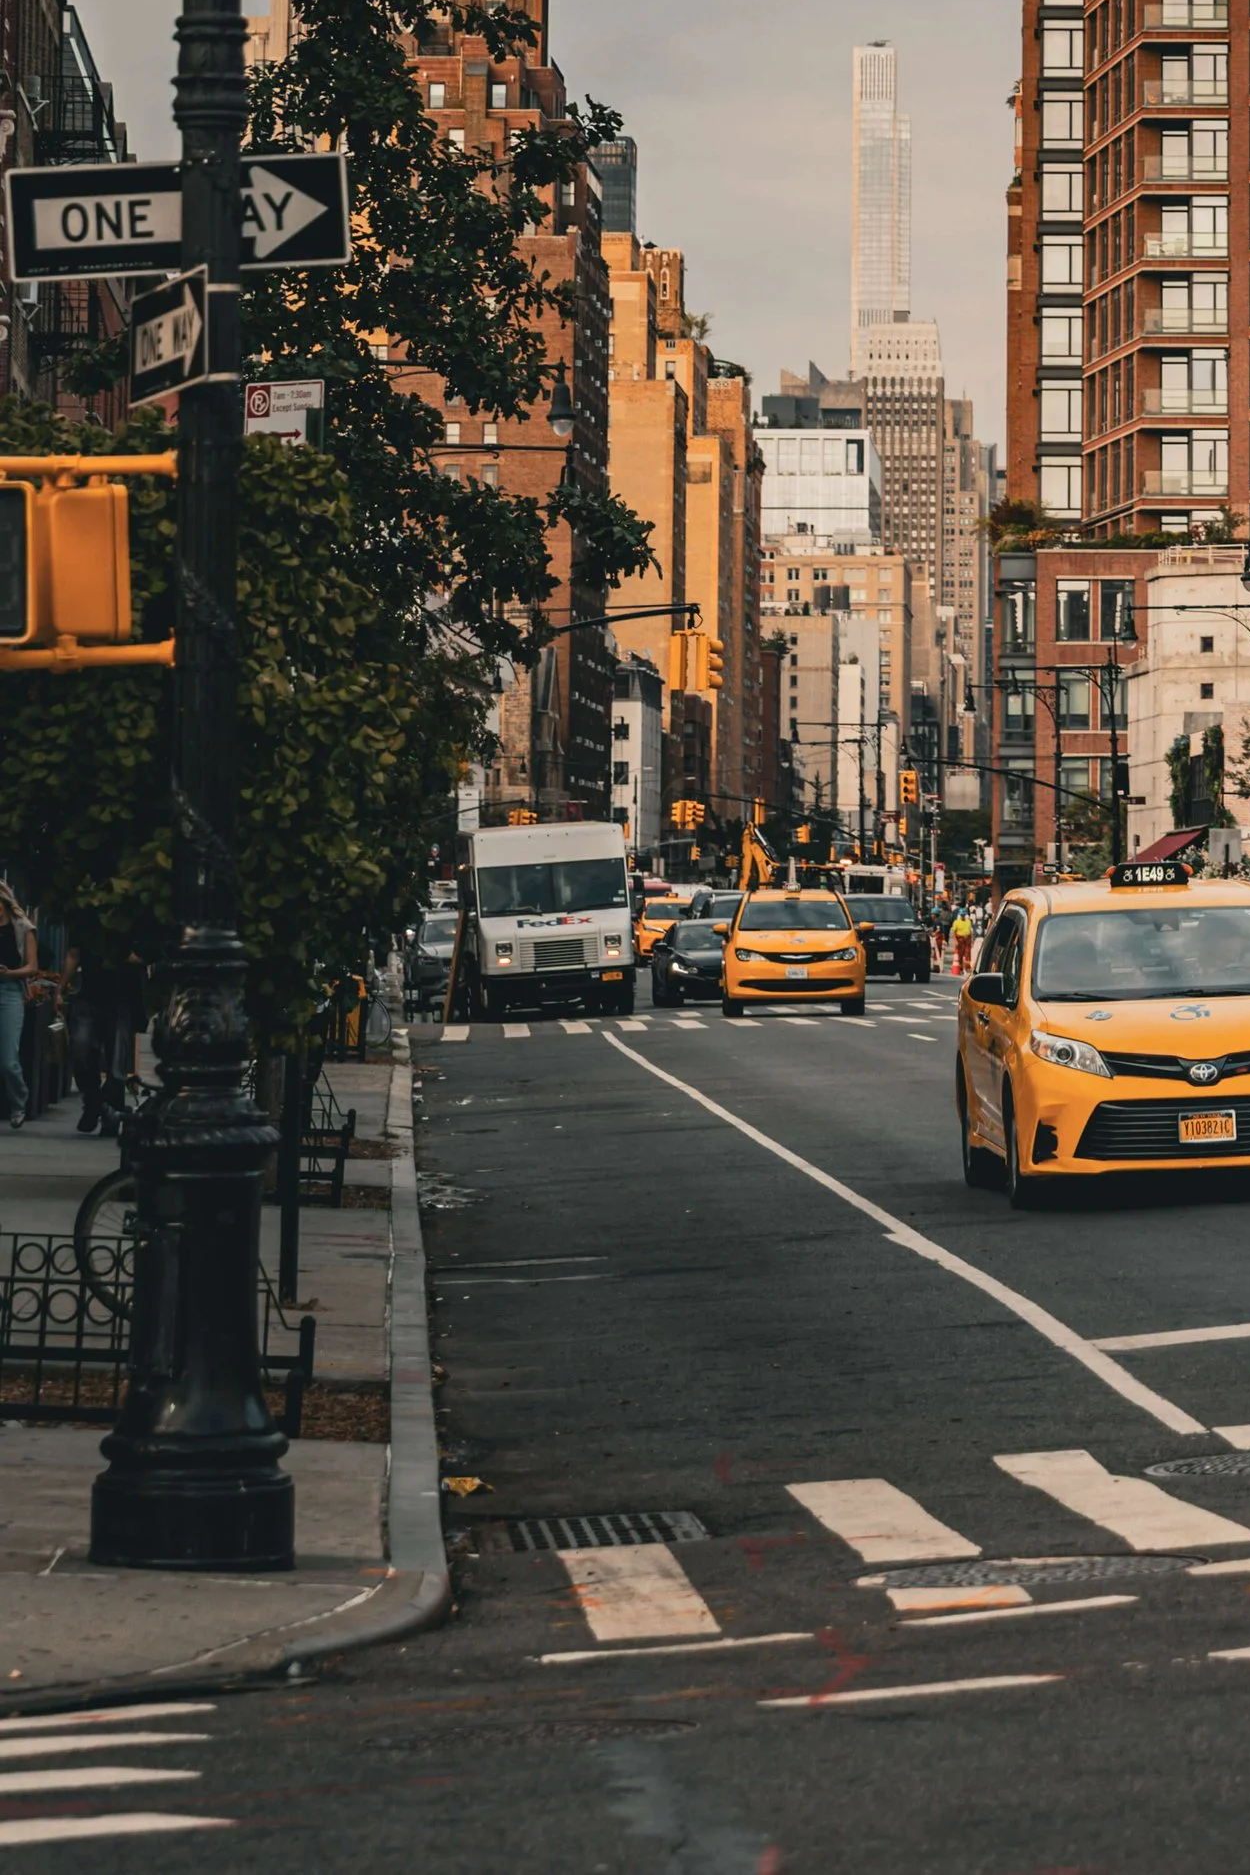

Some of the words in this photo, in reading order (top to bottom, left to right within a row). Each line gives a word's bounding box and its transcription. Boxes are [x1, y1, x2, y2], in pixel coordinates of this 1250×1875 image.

[61, 199, 154, 243] ONE
[241, 191, 293, 232] AY
[141, 321, 163, 367] ONE
[173, 307, 196, 355] WAY
[1135, 866, 1164, 882] 1E49
[516, 915, 593, 929] FedEx
